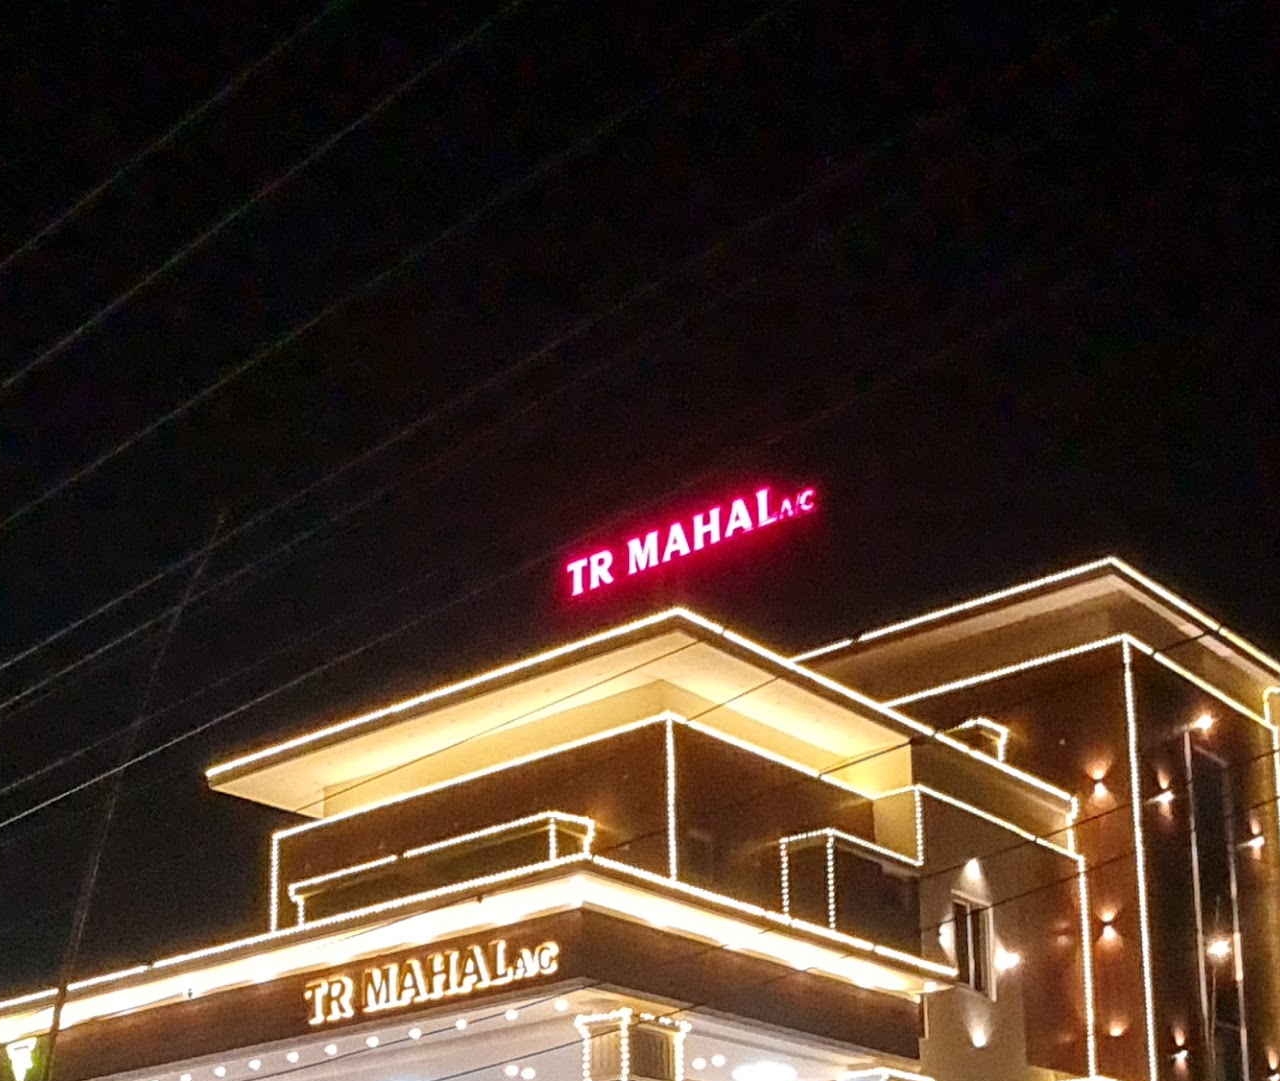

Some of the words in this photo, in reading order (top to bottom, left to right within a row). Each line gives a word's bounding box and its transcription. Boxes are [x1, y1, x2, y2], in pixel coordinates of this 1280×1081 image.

[567, 550, 615, 597] TR
[627, 487, 777, 576] MAHAL
[305, 975, 355, 1026] TR
[362, 940, 513, 1013] MAHAL
